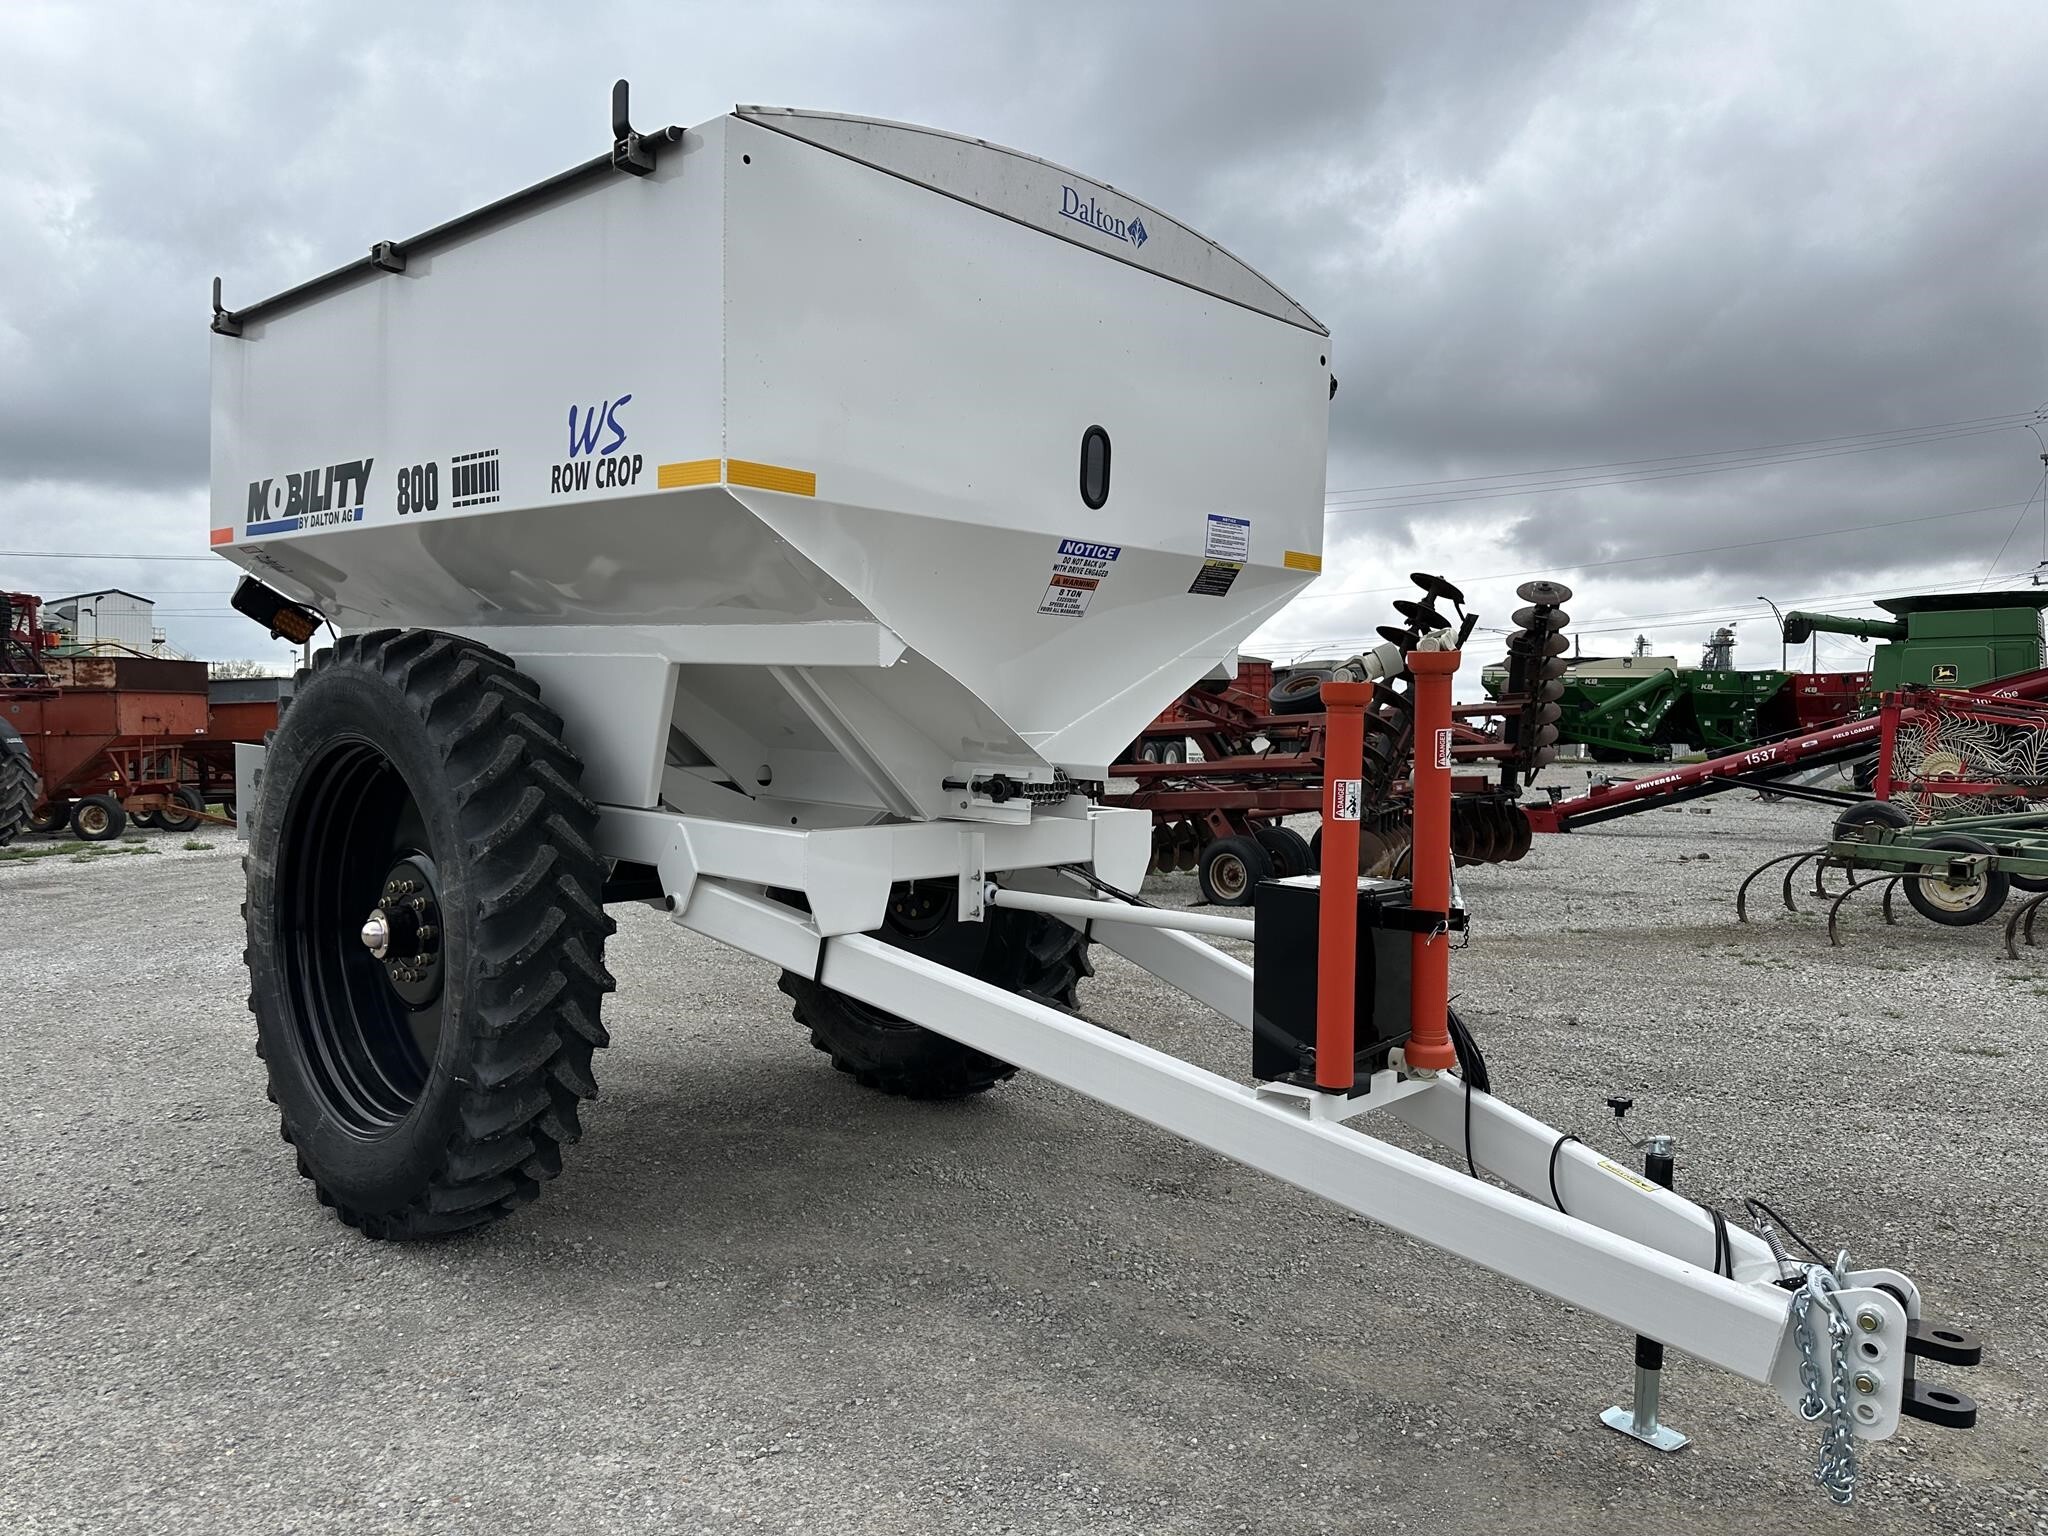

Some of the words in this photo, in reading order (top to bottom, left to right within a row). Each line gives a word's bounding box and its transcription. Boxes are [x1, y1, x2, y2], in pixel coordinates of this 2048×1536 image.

[1061, 185, 1127, 237] Dalton
[569, 394, 632, 458] WS
[551, 461, 591, 493] ROW
[595, 454, 643, 488] CROP
[247, 458, 374, 523] MOBILITY
[397, 462, 438, 515] 800
[299, 515, 309, 529] BY
[310, 511, 340, 527] DALTON
[341, 509, 353, 523] AG
[1063, 541, 1116, 559] NOTICE
[1052, 563, 1067, 571] WITH
[1067, 565, 1084, 575] DRIVE
[1084, 567, 1109, 578] ENGAGED
[1062, 556, 1071, 564] DO
[1071, 557, 1083, 565] NOT
[1083, 559, 1099, 568] BACK
[1098, 561, 1107, 569] UP
[1062, 578, 1096, 588] WARNING
[1066, 589, 1083, 598] TON
[1832, 731, 1850, 739] FIELD
[1850, 725, 1875, 735] LOADER
[1744, 748, 1777, 765] 1537
[1634, 774, 1682, 791] UNIVERSAL
[1337, 782, 1345, 809] DANGER
